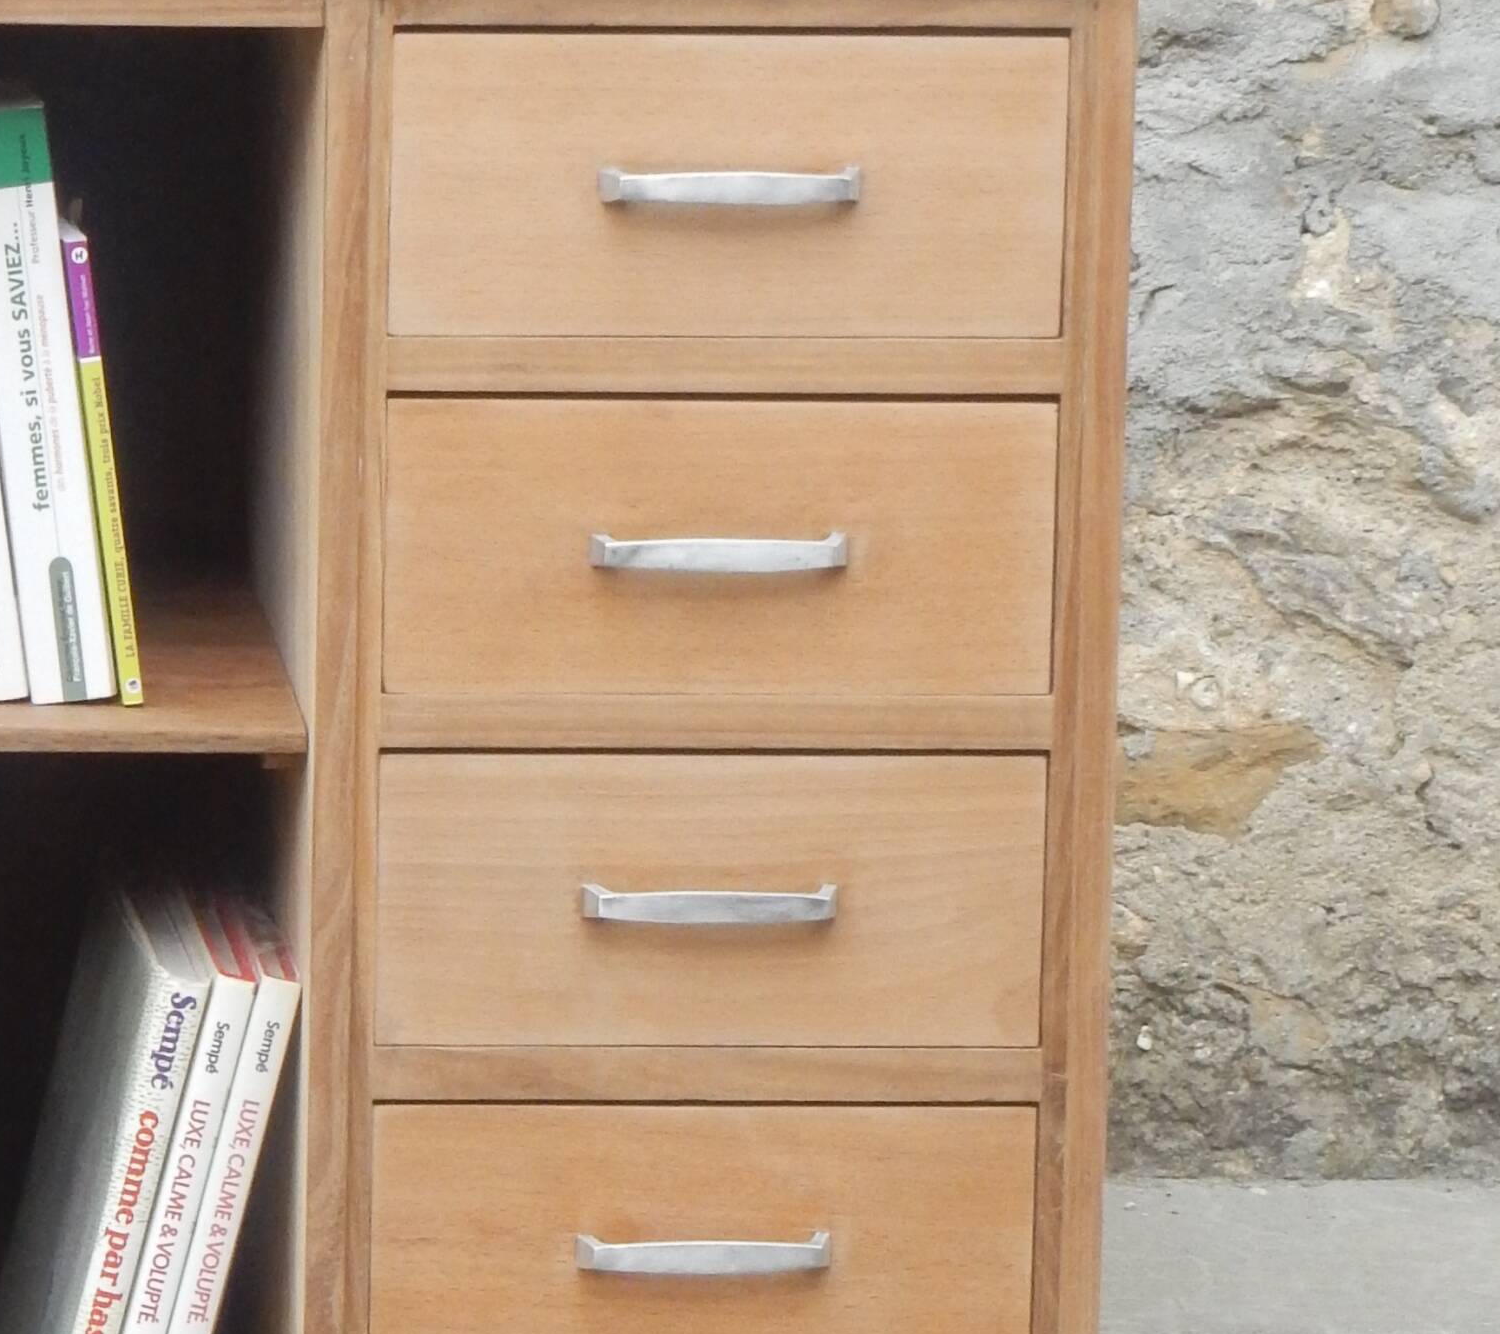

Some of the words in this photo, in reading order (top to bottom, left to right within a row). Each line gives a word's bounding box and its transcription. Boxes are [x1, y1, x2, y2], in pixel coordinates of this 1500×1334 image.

[24, 177, 33, 208] Henri
[28, 211, 41, 264] Professeur
[4, 222, 28, 321] SAVIEZ...
[17, 328, 35, 382] vous
[20, 389, 38, 407] si
[92, 377, 104, 408] Nobel
[98, 412, 109, 435] prix
[29, 415, 50, 511] femmes,
[100, 438, 111, 464] trois
[111, 516, 124, 553] quatre
[118, 595, 133, 641] FAMILLE
[125, 644, 135, 658] LA
[151, 992, 197, 1090] Sempé
[205, 1021, 230, 1074] Sempé
[255, 1021, 280, 1074] Sempé
[180, 1100, 211, 1150] LUXE,
[228, 1100, 260, 1150] LUXE,
[115, 1110, 159, 1225] comme
[164, 1154, 196, 1221] CALME
[214, 1154, 245, 1221] CALME
[159, 1223, 178, 1238] &
[208, 1223, 228, 1238] &
[99, 1227, 130, 1287] par
